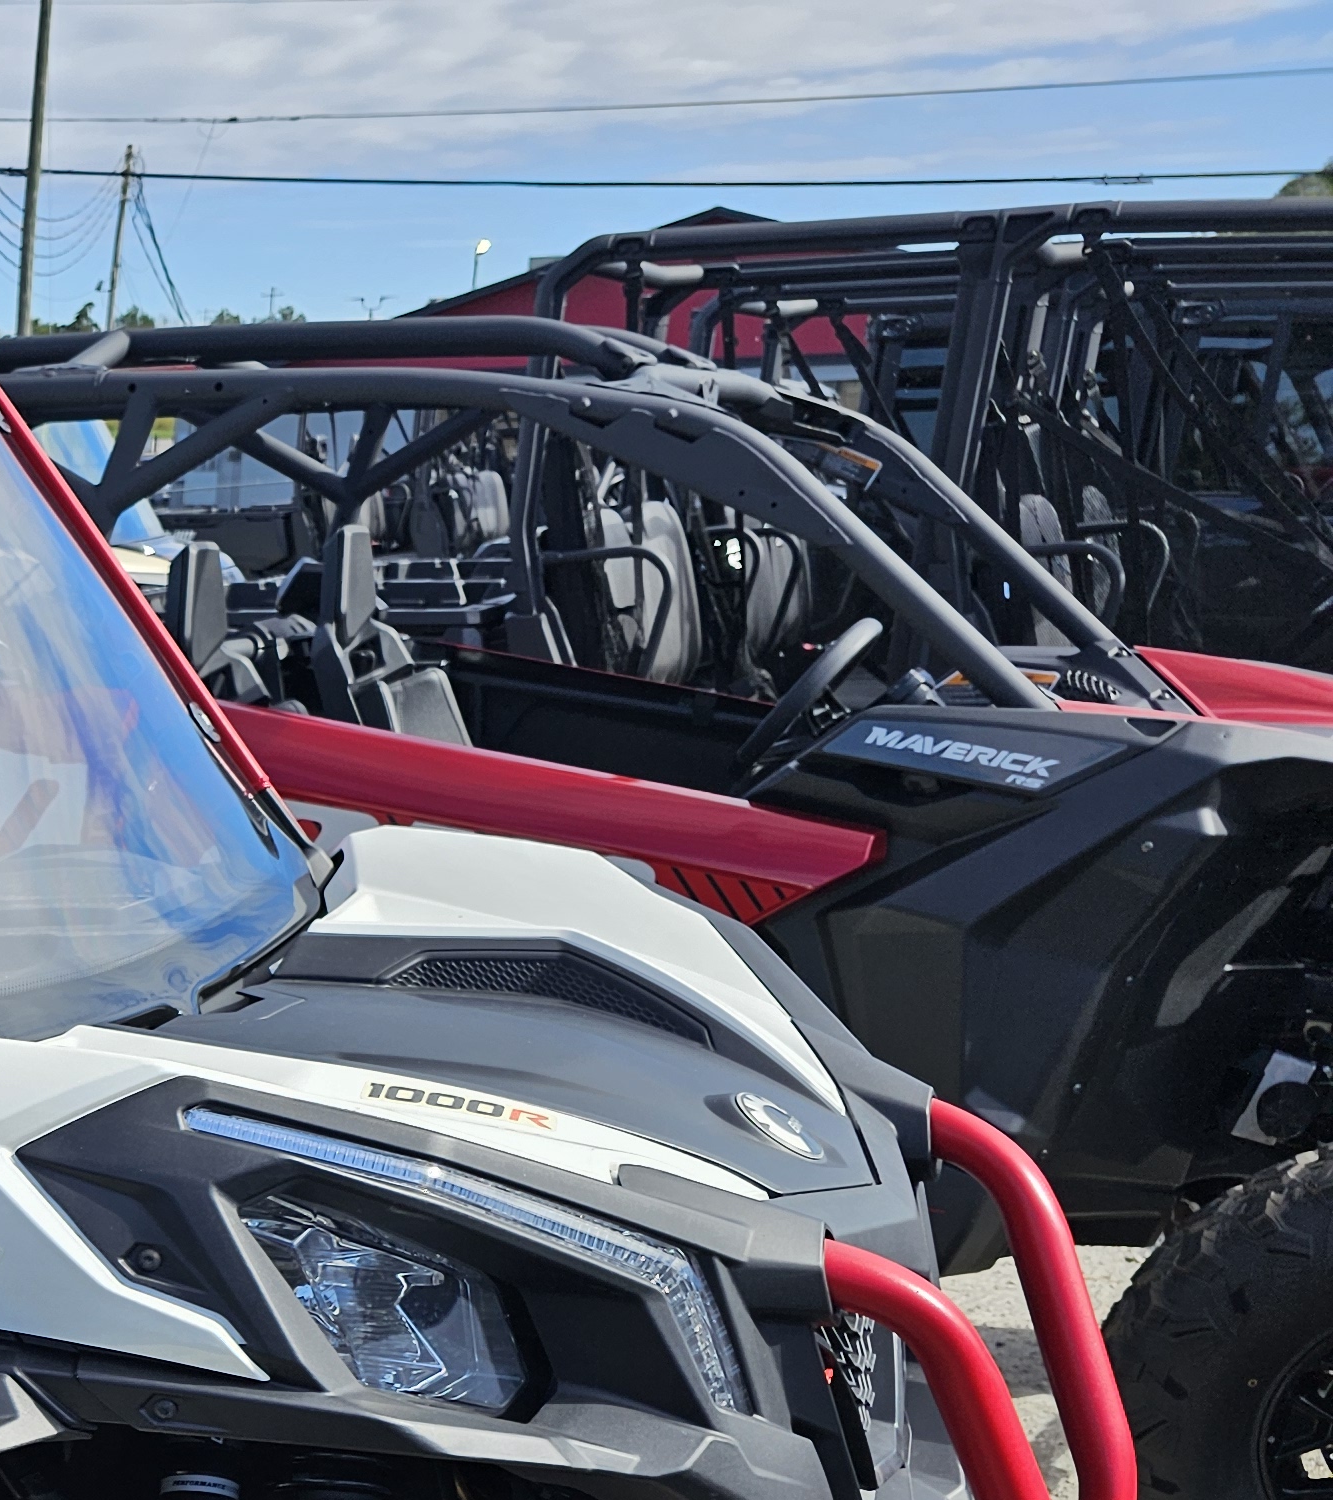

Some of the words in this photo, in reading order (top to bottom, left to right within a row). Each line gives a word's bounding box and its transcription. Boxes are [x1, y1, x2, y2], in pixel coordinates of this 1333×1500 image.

[865, 725, 1060, 778] MAVERICK
[1004, 773, 1046, 789] RS
[368, 1082, 552, 1130] 1000R
[173, 1480, 227, 1490] PERFORMANCE
